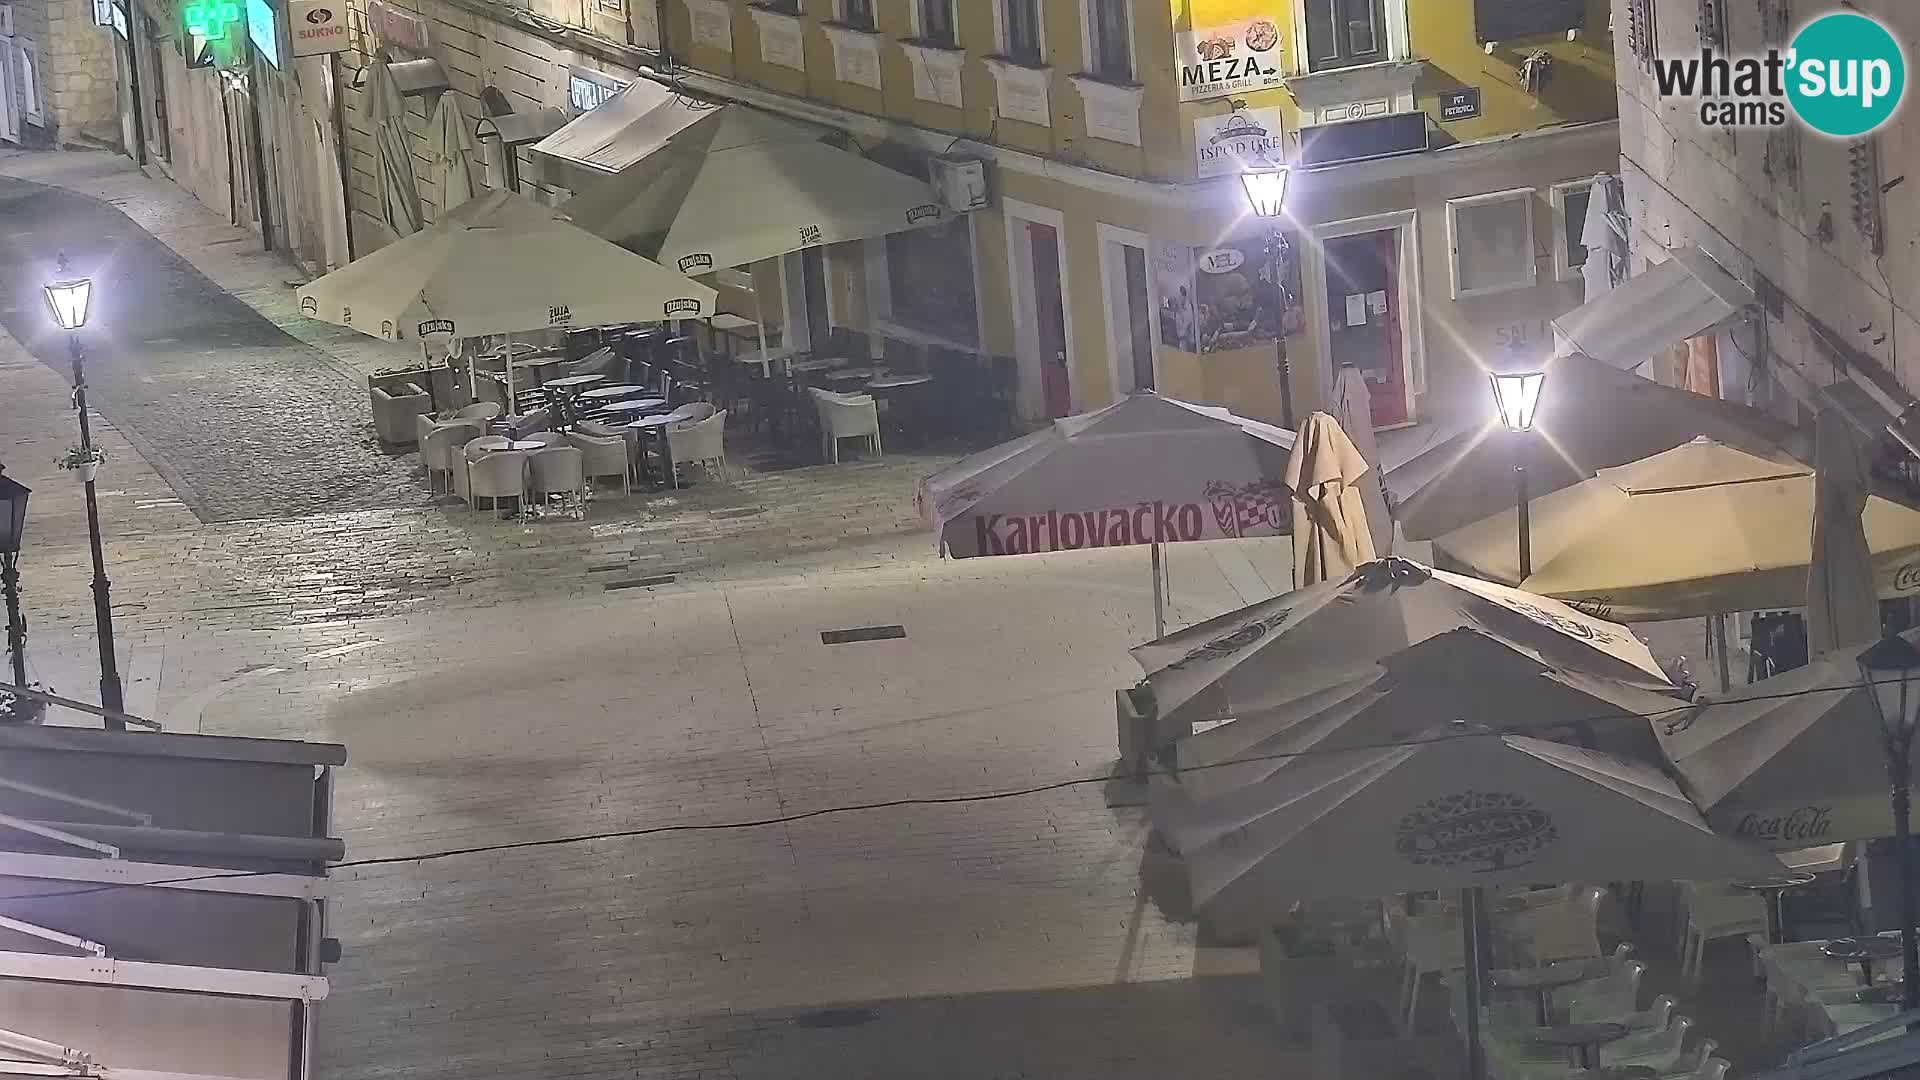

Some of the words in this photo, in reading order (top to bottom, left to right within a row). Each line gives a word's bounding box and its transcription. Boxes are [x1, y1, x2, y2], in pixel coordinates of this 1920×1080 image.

[299, 26, 343, 39] SUKNO
[1182, 56, 1261, 86] MEZA
[1192, 82, 1224, 95] PIZZERIA
[1232, 79, 1253, 89] GRILL
[1200, 142, 1246, 160] ISPOD
[975, 501, 1202, 555] Karlovačko
